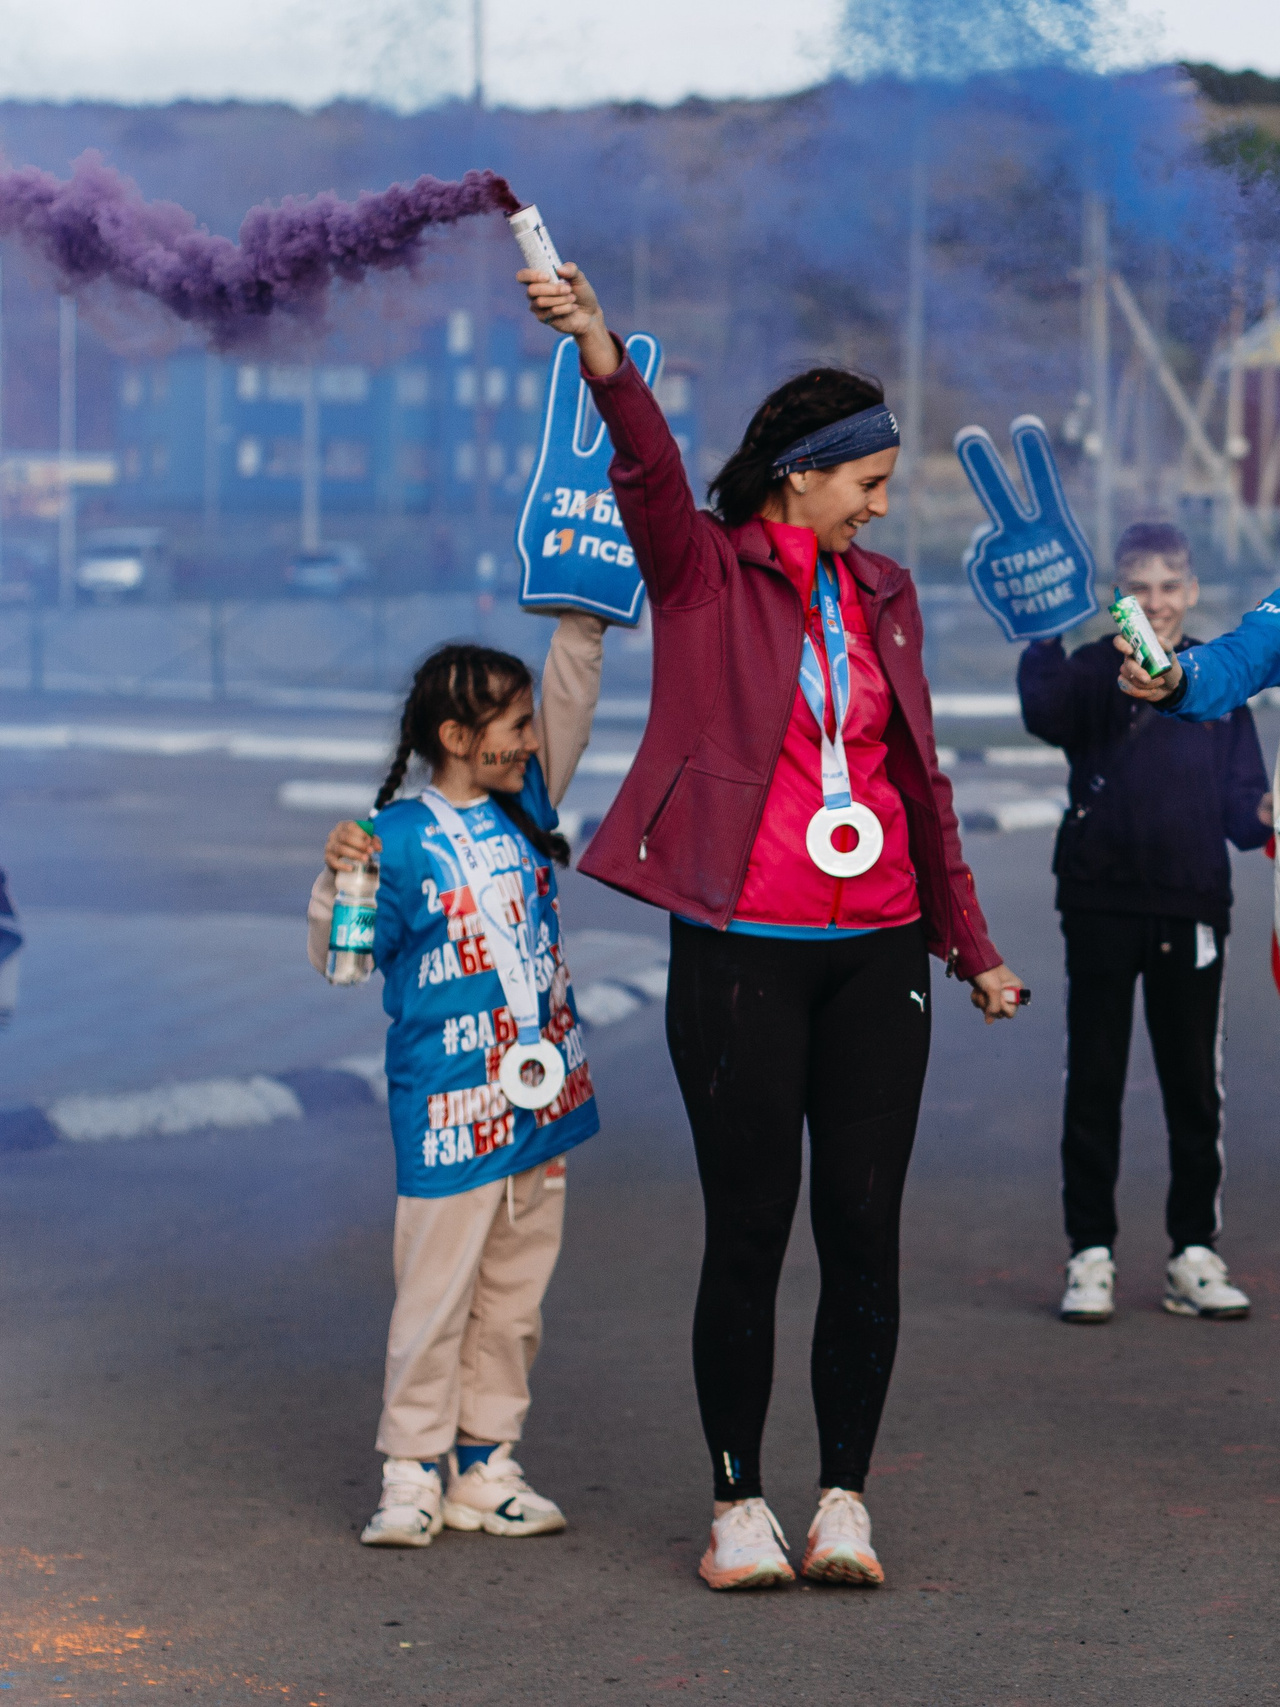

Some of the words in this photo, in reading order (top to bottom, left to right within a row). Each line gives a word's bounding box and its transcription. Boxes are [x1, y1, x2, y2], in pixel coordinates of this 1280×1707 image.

[551, 487, 588, 520] ЗА
[578, 535, 636, 567] ПСБ
[990, 539, 1065, 578] СТРАНА
[993, 580, 1009, 599] В
[1008, 556, 1076, 596] ОДНОМ
[1011, 581, 1075, 615] РИТМЕ
